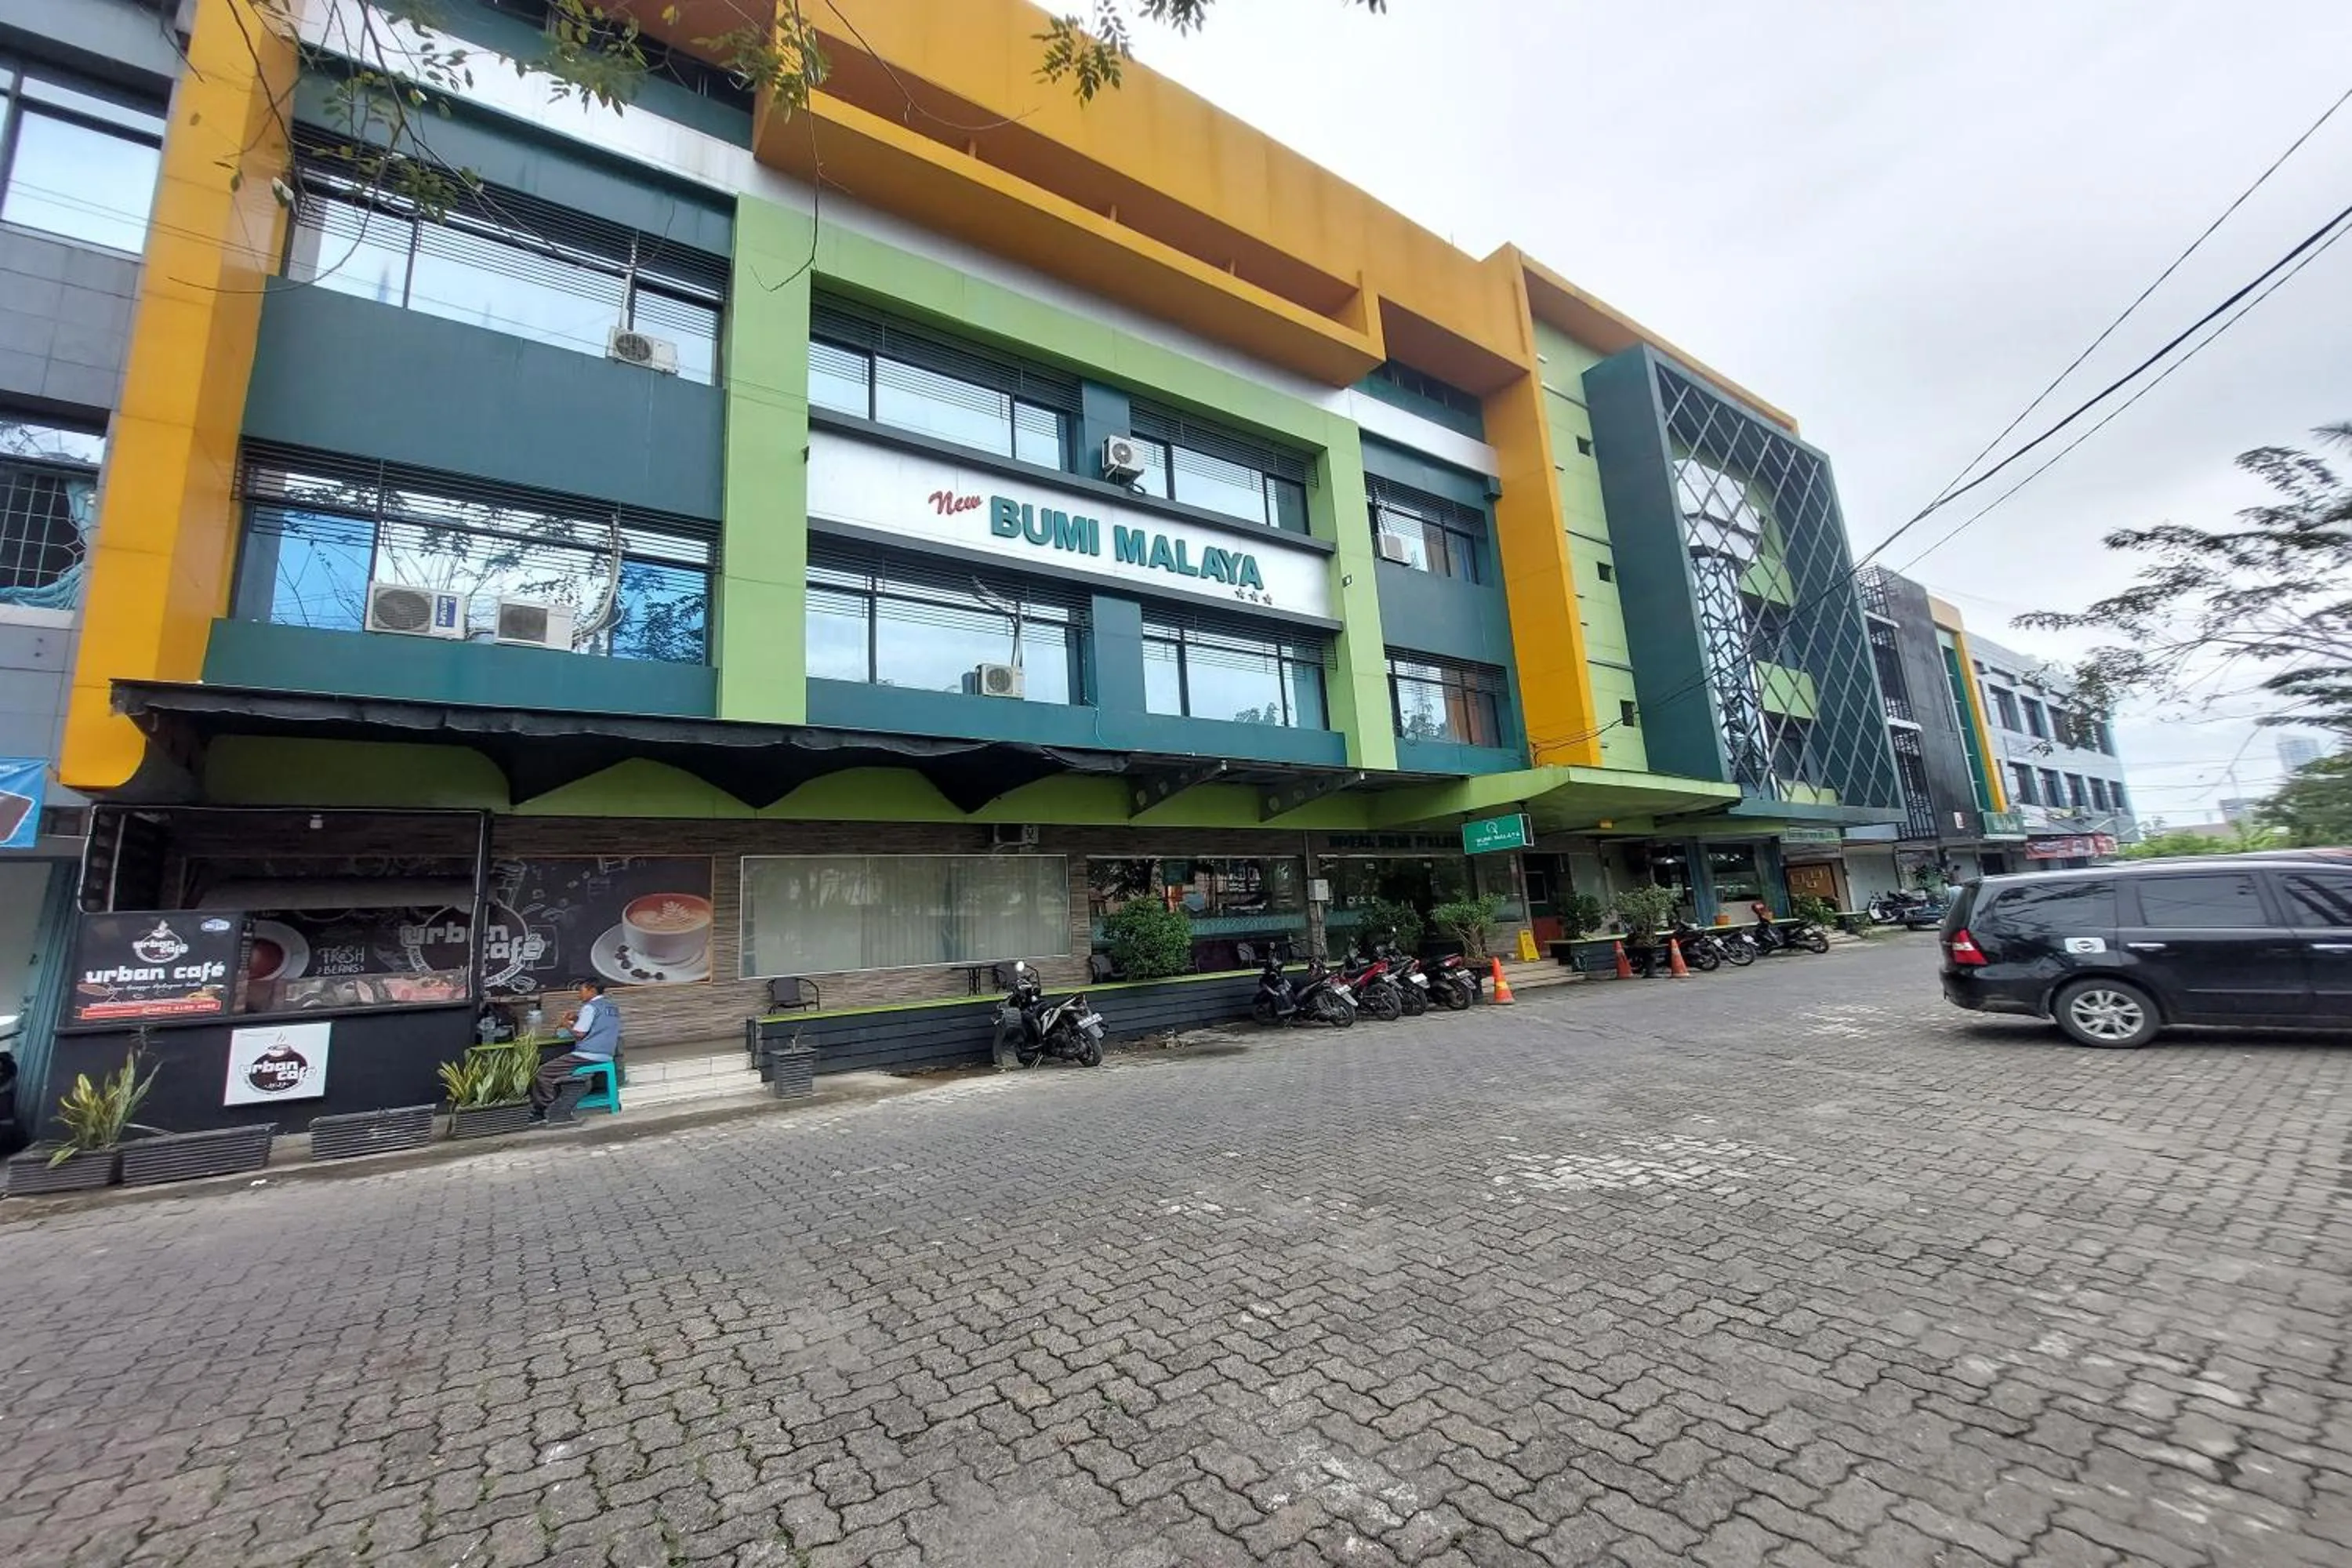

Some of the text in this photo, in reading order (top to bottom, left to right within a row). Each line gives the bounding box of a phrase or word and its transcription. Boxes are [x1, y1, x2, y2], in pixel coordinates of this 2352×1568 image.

[928, 490, 1265, 590] New BUMI MALAYA
[400, 921, 509, 946] urbn
[484, 932, 546, 964] afé
[85, 960, 227, 984] urban café
[324, 964, 360, 975] BEANS
[238, 1060, 299, 1075] urban
